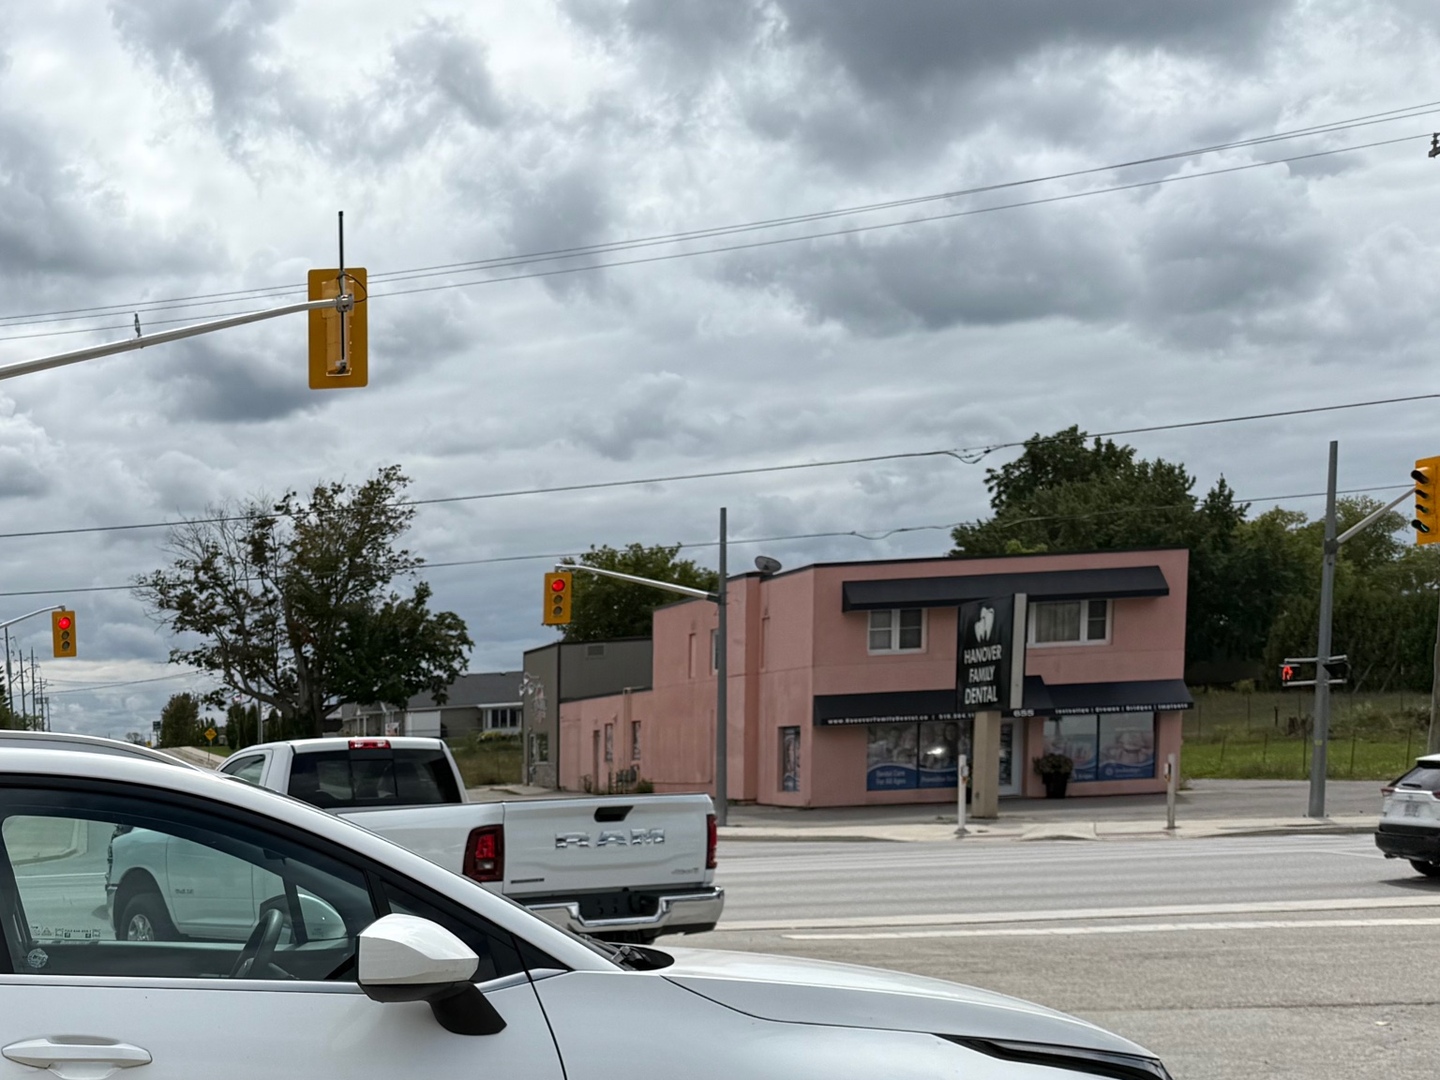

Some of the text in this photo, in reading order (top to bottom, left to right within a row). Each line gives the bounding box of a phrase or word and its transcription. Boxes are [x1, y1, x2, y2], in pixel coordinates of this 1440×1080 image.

[964, 644, 1002, 665] HANOVER
[968, 665, 996, 683] FAMILY
[964, 685, 998, 705] DENTAL
[555, 828, 665, 849] RAM
